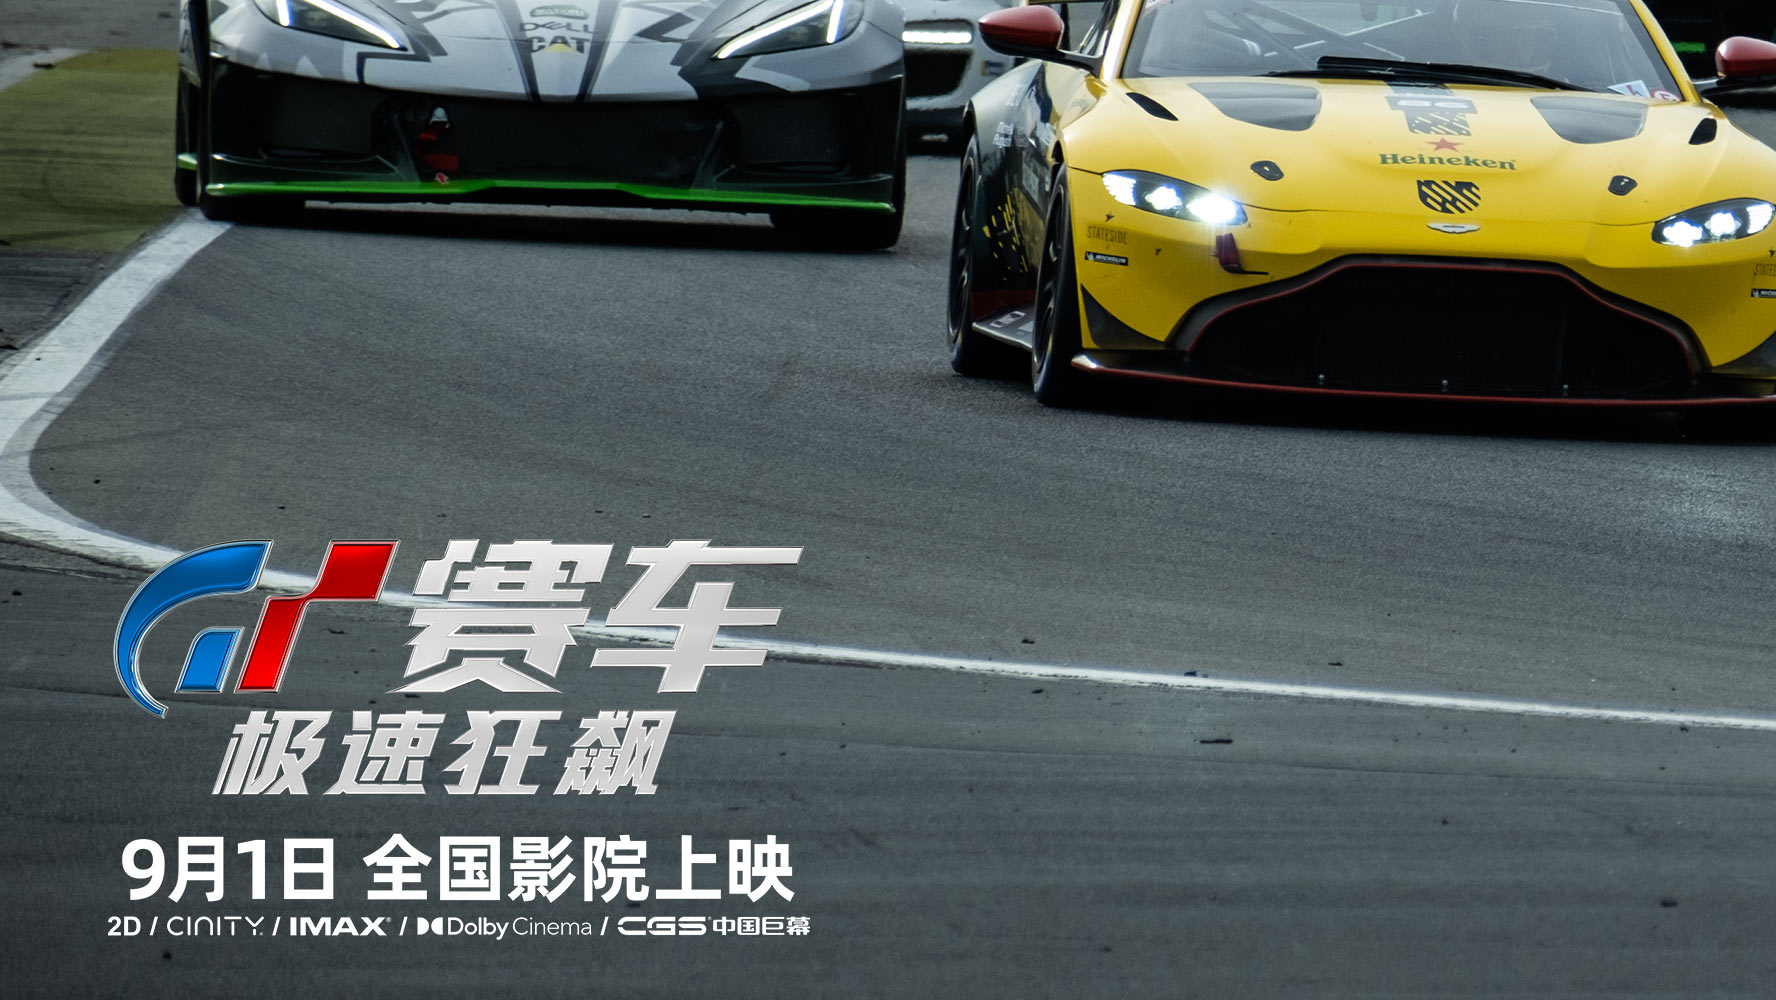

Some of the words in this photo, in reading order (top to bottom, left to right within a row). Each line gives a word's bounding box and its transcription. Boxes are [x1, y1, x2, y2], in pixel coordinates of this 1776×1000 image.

[519, 21, 597, 34] DELL
[529, 36, 591, 54] CAT
[1378, 152, 1516, 171] Heineken
[1086, 224, 1129, 246] STATESIDE
